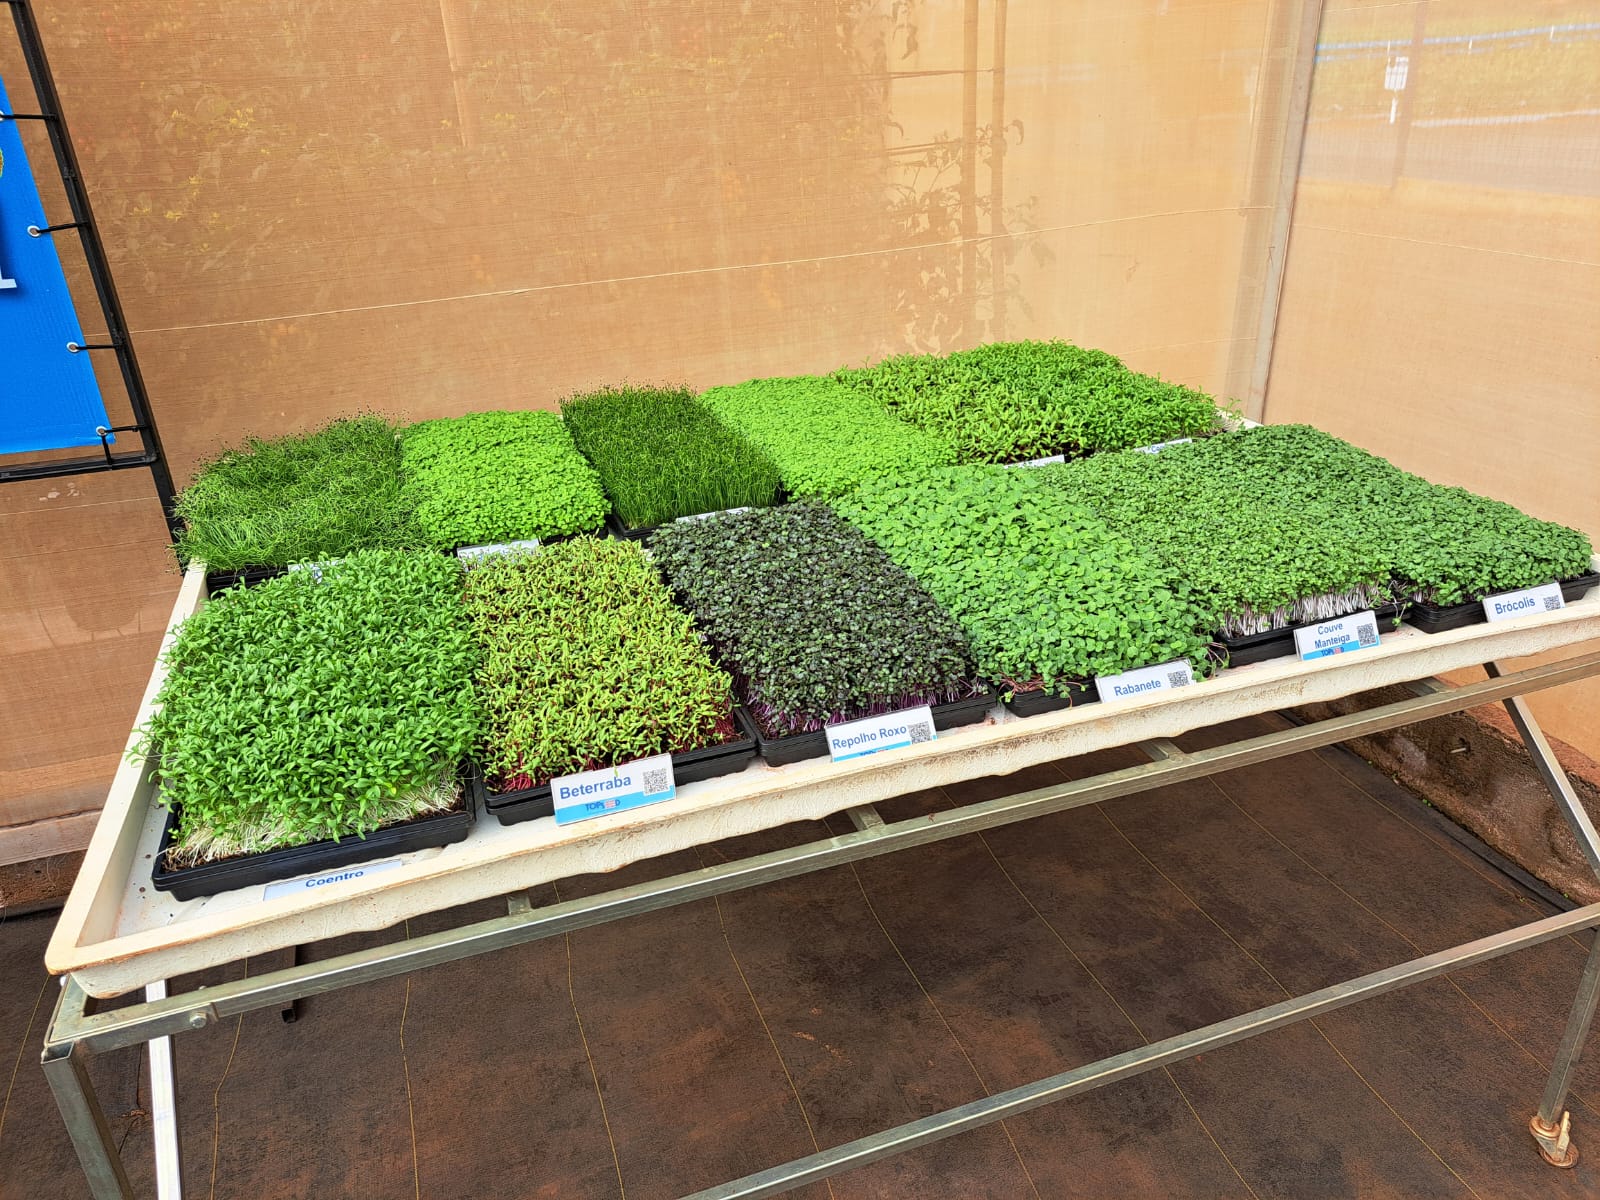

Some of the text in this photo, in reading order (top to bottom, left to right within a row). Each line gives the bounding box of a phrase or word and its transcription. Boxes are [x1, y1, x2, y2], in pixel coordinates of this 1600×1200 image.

[1495, 595, 1535, 614] Brócolis
[1318, 623, 1343, 635] Couve
[1315, 634, 1350, 649] Manteiga
[1113, 680, 1161, 696] Rabanete
[832, 725, 907, 749] Repolho Roxo
[560, 776, 631, 800] Beterraba
[305, 870, 364, 888] Coentro
